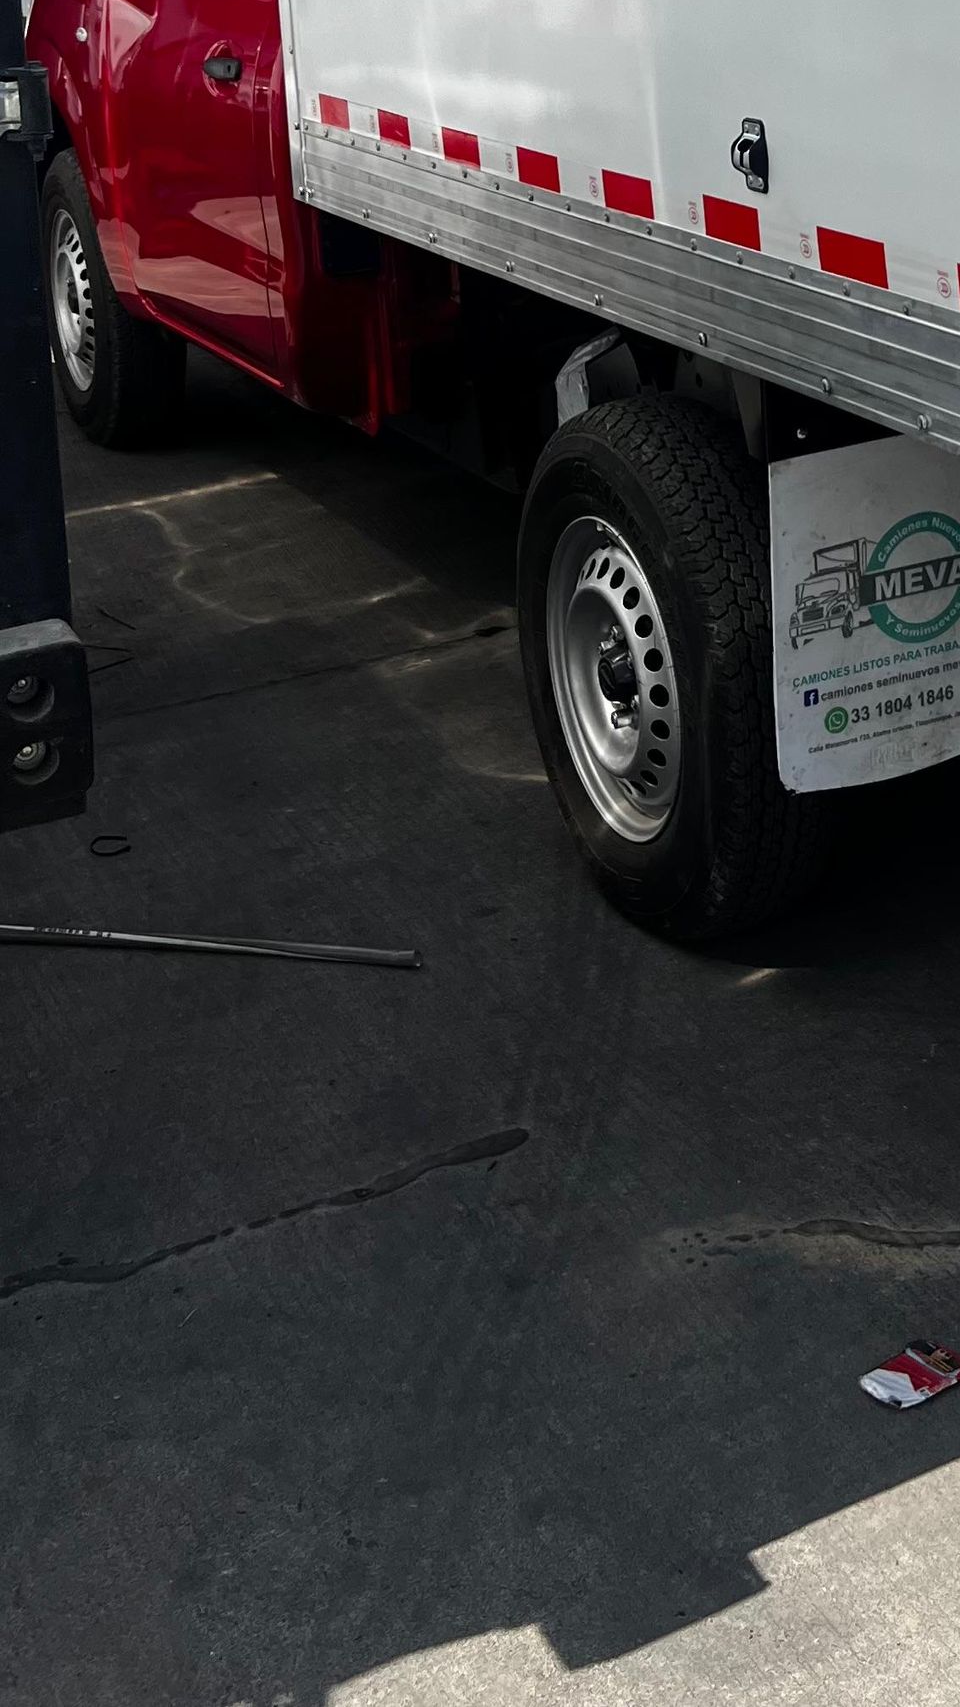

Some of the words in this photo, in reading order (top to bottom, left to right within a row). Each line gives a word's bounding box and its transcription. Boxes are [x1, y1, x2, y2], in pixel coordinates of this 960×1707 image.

[877, 519, 928, 563] Camiones
[885, 613, 895, 625] Y
[792, 667, 850, 688] CAMIONES
[853, 657, 891, 674] LISTOS
[893, 649, 922, 665] PARA
[820, 681, 874, 701] camiones
[876, 664, 940, 688] seminuevos
[851, 705, 870, 724] 33
[875, 694, 913, 717] 1804
[917, 685, 954, 707] 1846
